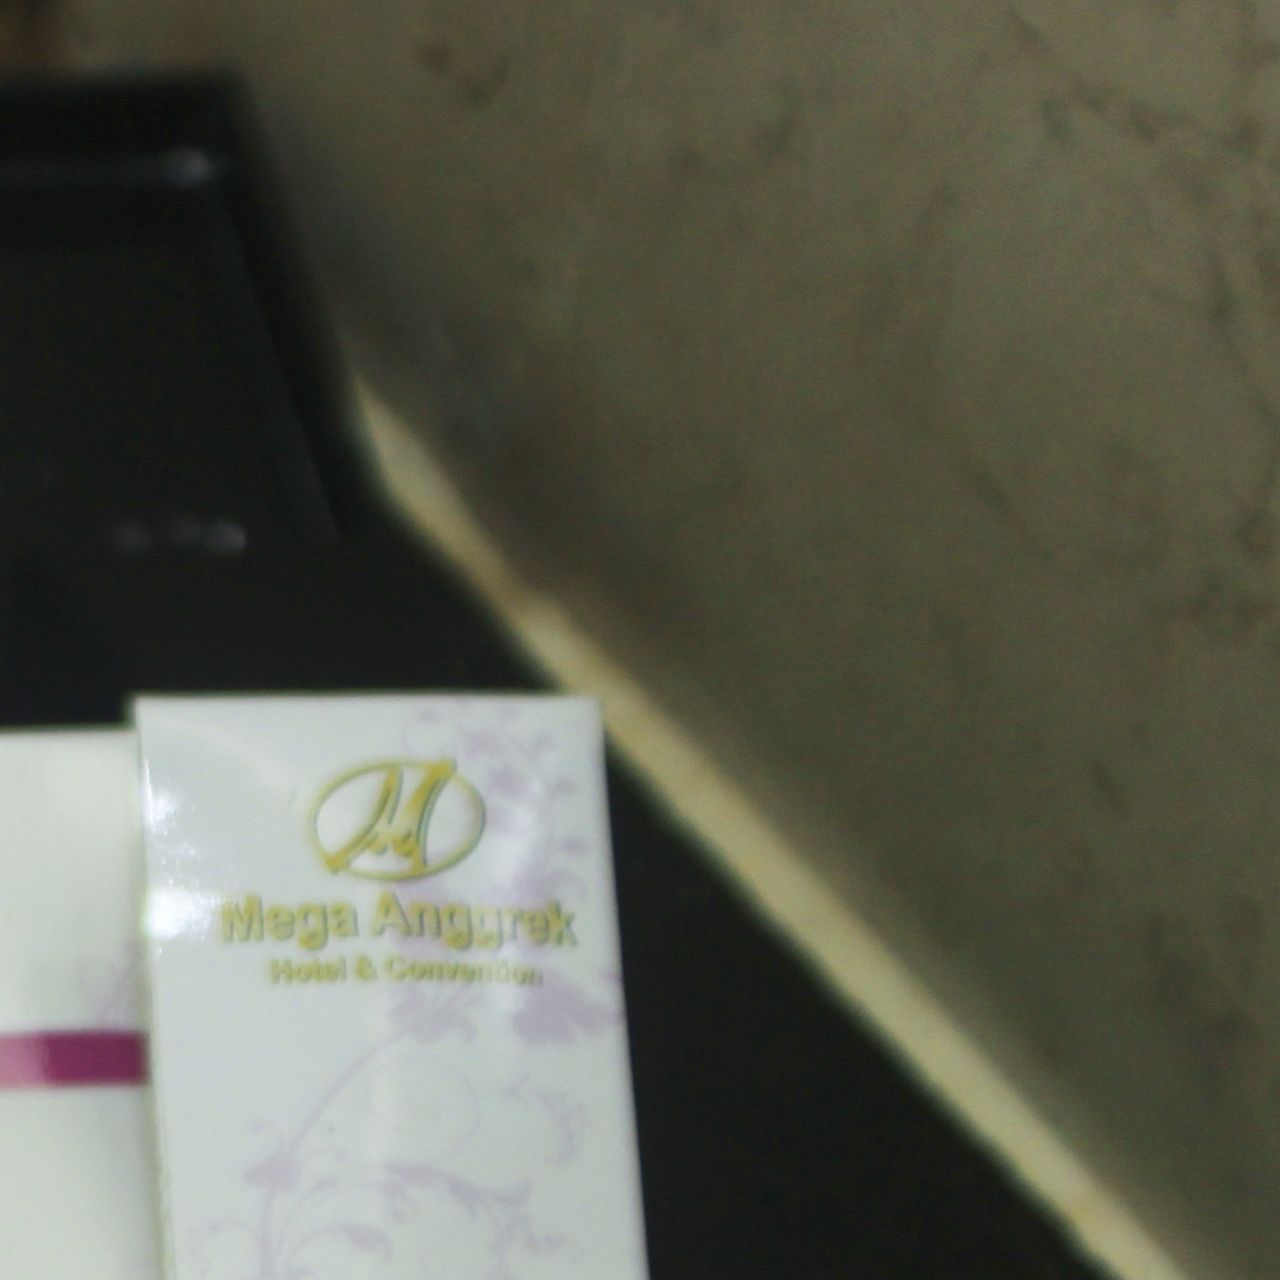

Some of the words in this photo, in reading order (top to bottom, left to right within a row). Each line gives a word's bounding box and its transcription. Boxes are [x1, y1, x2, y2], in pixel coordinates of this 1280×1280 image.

[221, 894, 359, 950] Mega
[372, 890, 578, 951] Anggrek
[269, 957, 346, 983] Hotel
[355, 956, 377, 981] &
[385, 957, 543, 986] Convention
